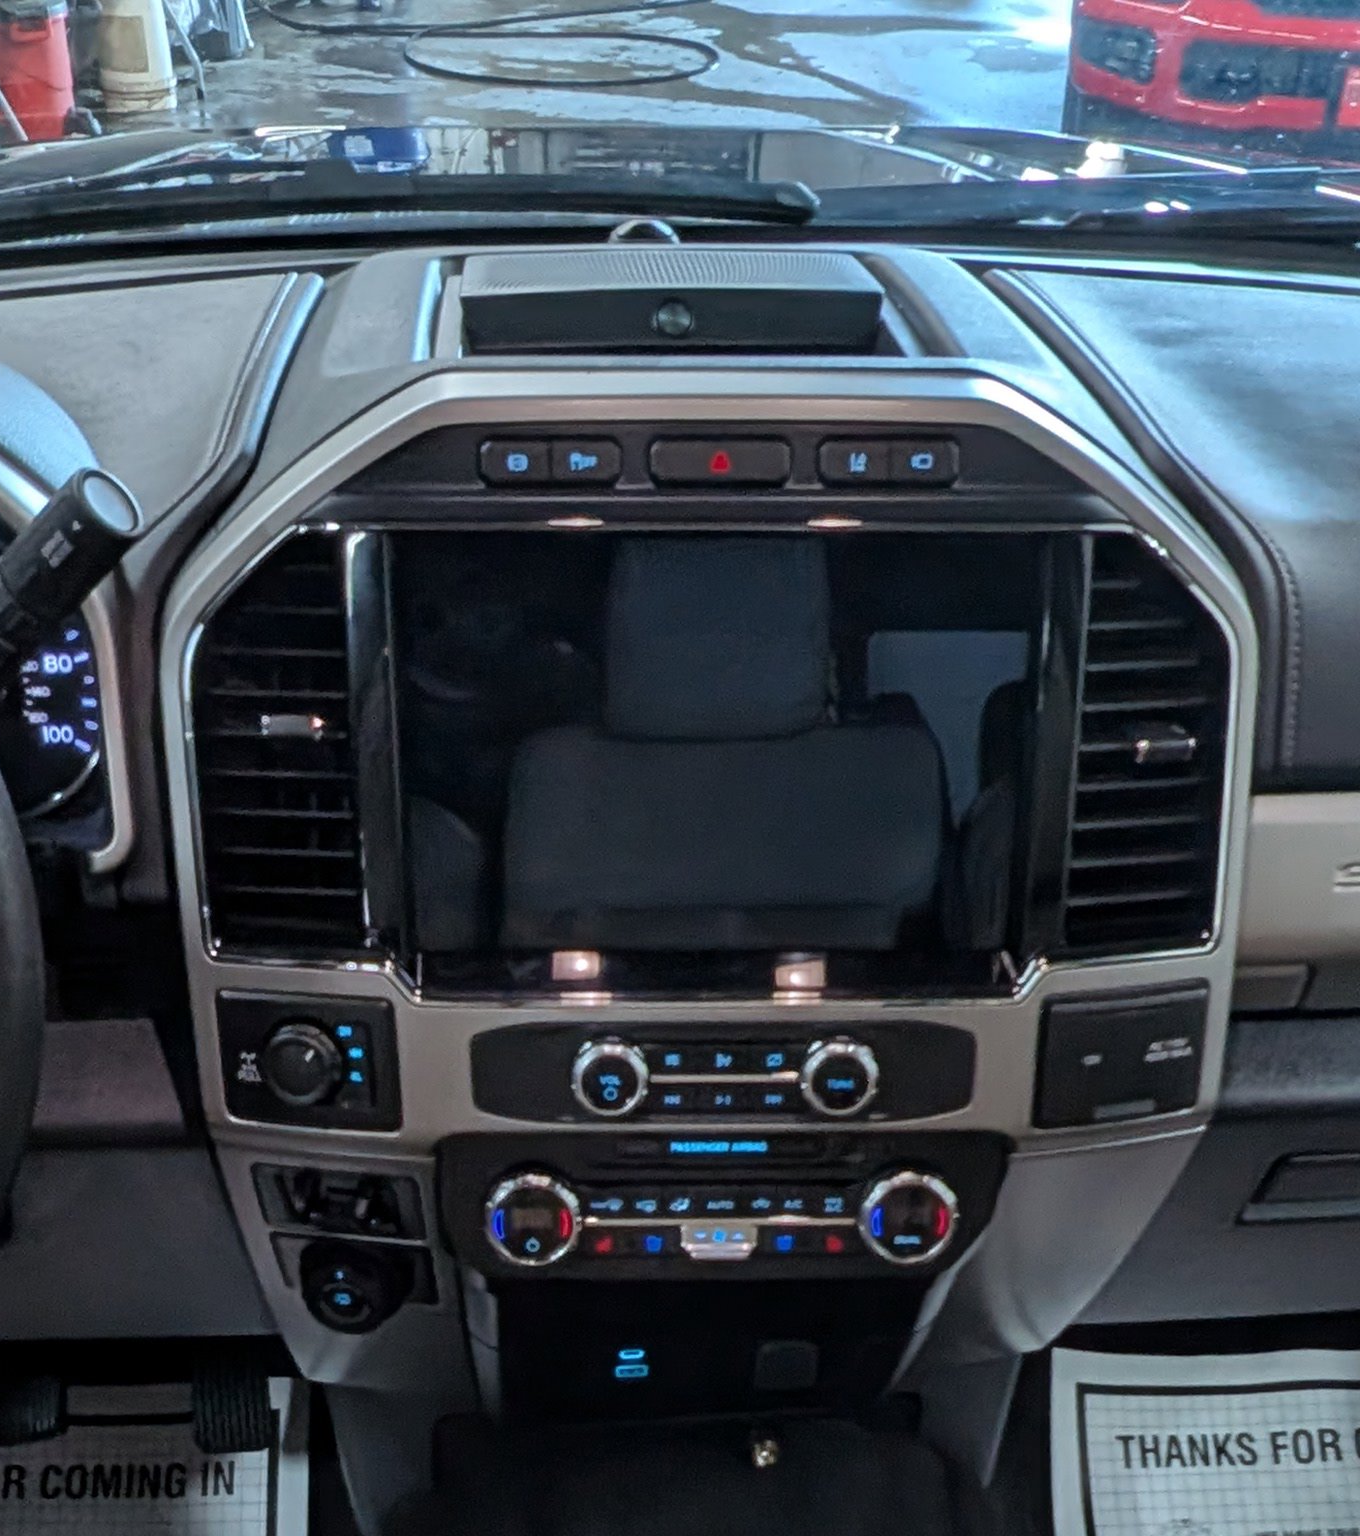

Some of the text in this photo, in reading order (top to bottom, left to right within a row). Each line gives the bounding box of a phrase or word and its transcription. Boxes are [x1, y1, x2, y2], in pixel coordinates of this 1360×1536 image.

[43, 653, 73, 674] 80
[42, 725, 74, 744] 100
[669, 1140, 730, 1154] PASSENGER
[731, 1140, 768, 1153] AIRBAG
[706, 1200, 735, 1210] AUTO
[1115, 1431, 1258, 1469] THANKS
[1270, 1427, 1343, 1465] FOR
[40, 1462, 188, 1500] COMING
[199, 1460, 236, 1496] IN
